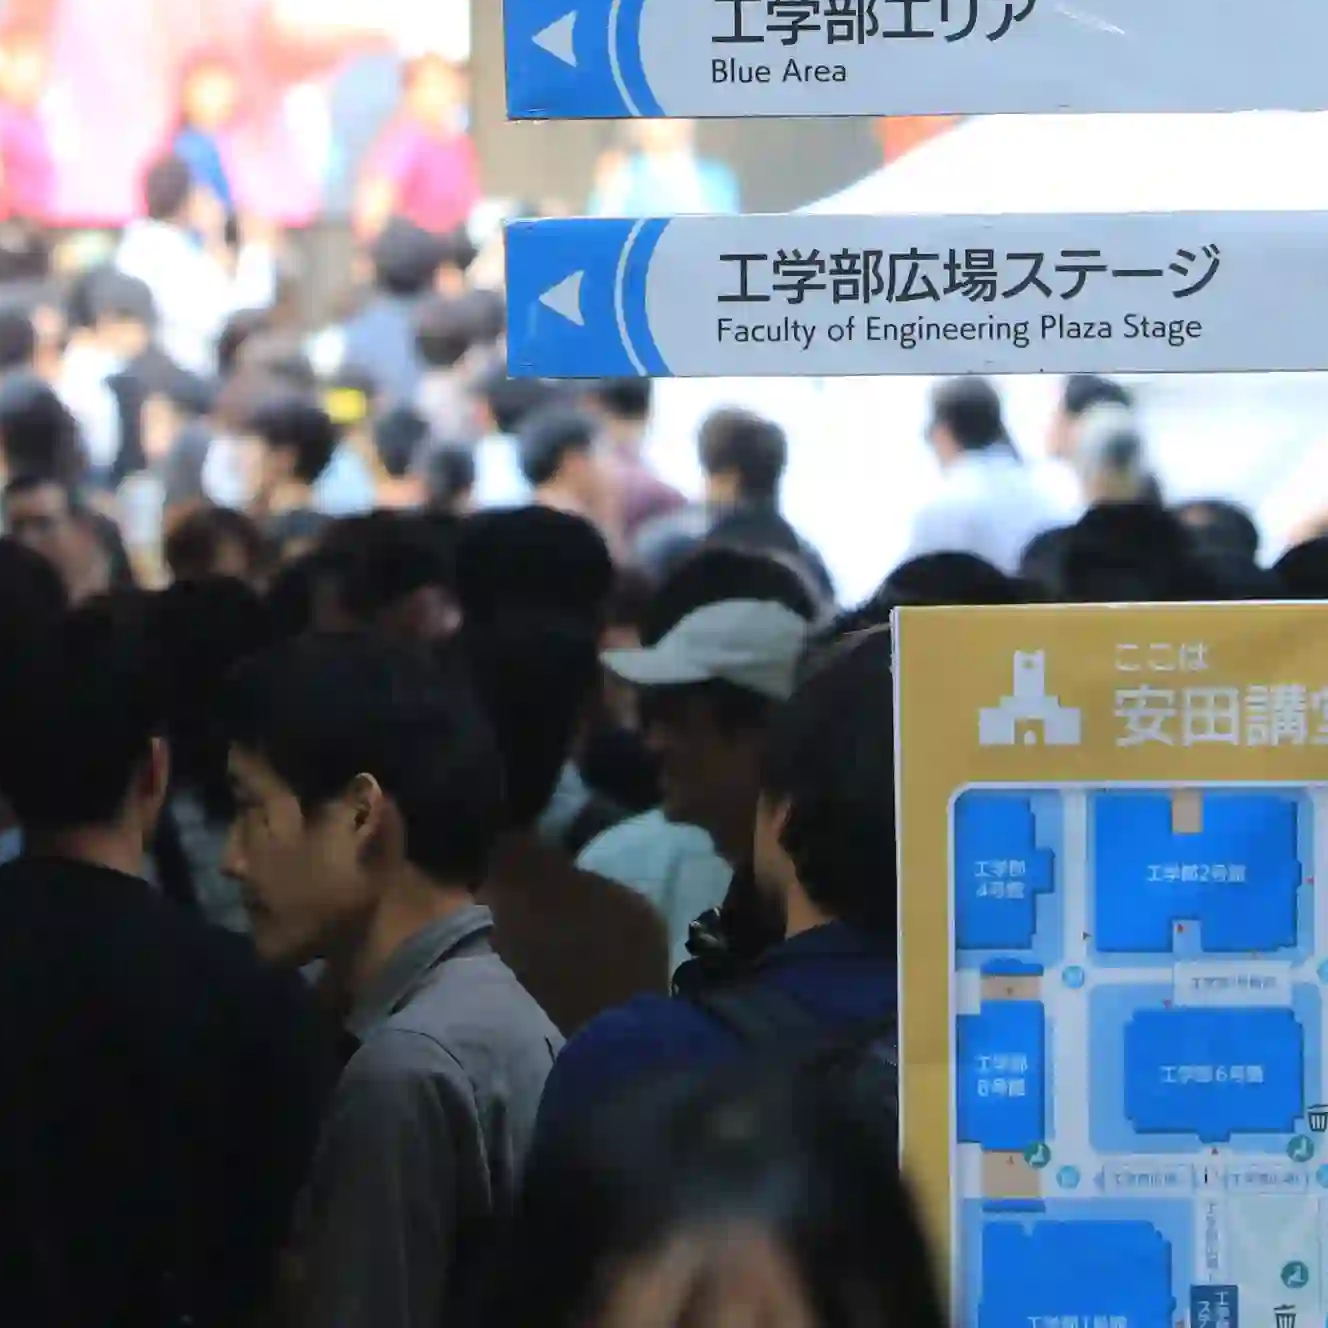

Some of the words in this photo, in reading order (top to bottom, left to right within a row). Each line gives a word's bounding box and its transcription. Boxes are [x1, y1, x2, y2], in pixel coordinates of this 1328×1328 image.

[711, 57, 771, 84] Blue
[783, 58, 847, 83] Area
[717, 243, 1221, 305] 工学部広場ステージ
[717, 316, 816, 350] Faculty
[827, 315, 855, 342] of
[866, 314, 1030, 350] Engineering
[1041, 313, 1112, 340] Plaza
[1123, 313, 1203, 347] Stage
[1115, 642, 1207, 671] ここは
